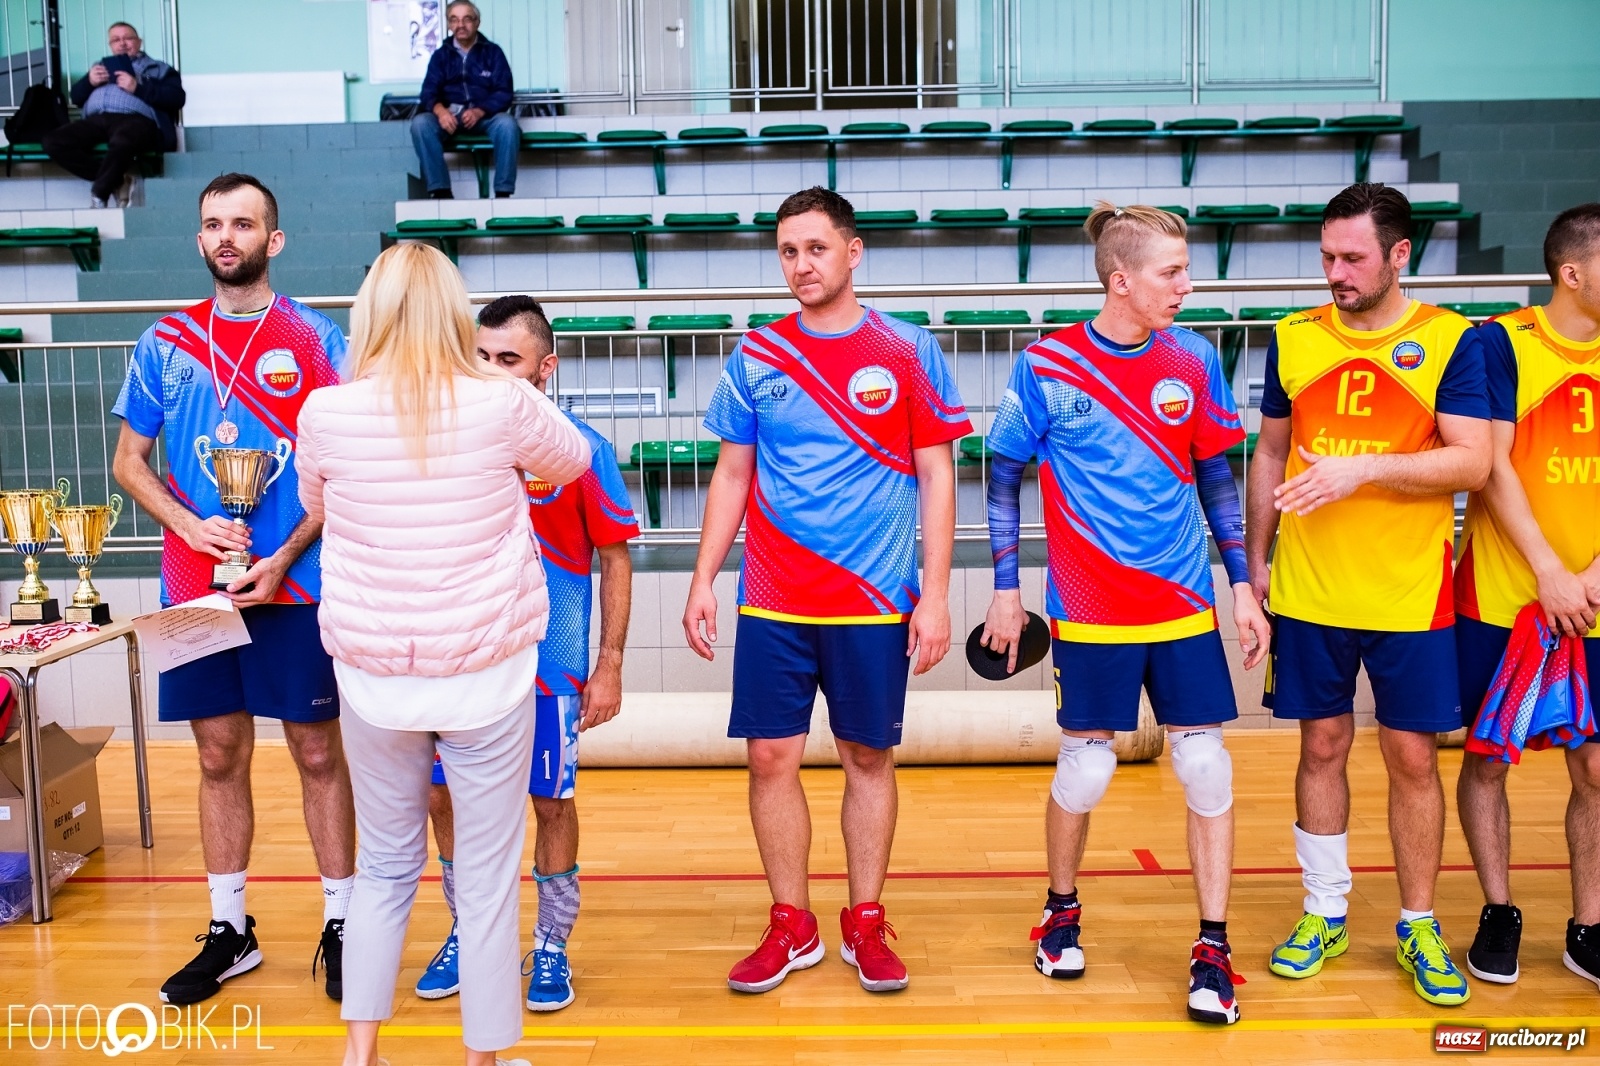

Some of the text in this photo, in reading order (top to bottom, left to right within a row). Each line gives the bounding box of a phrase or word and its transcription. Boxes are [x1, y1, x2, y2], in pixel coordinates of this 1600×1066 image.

[270, 374, 295, 384] ŚWIT
[863, 391, 887, 402] ŚWIT
[1336, 370, 1376, 417] 12
[1164, 403, 1185, 413] ŚWIT
[1571, 386, 1595, 433] 3
[528, 482, 553, 491] ŚWIT
[542, 750, 551, 780] 1
[54, 815, 64, 829] REF
